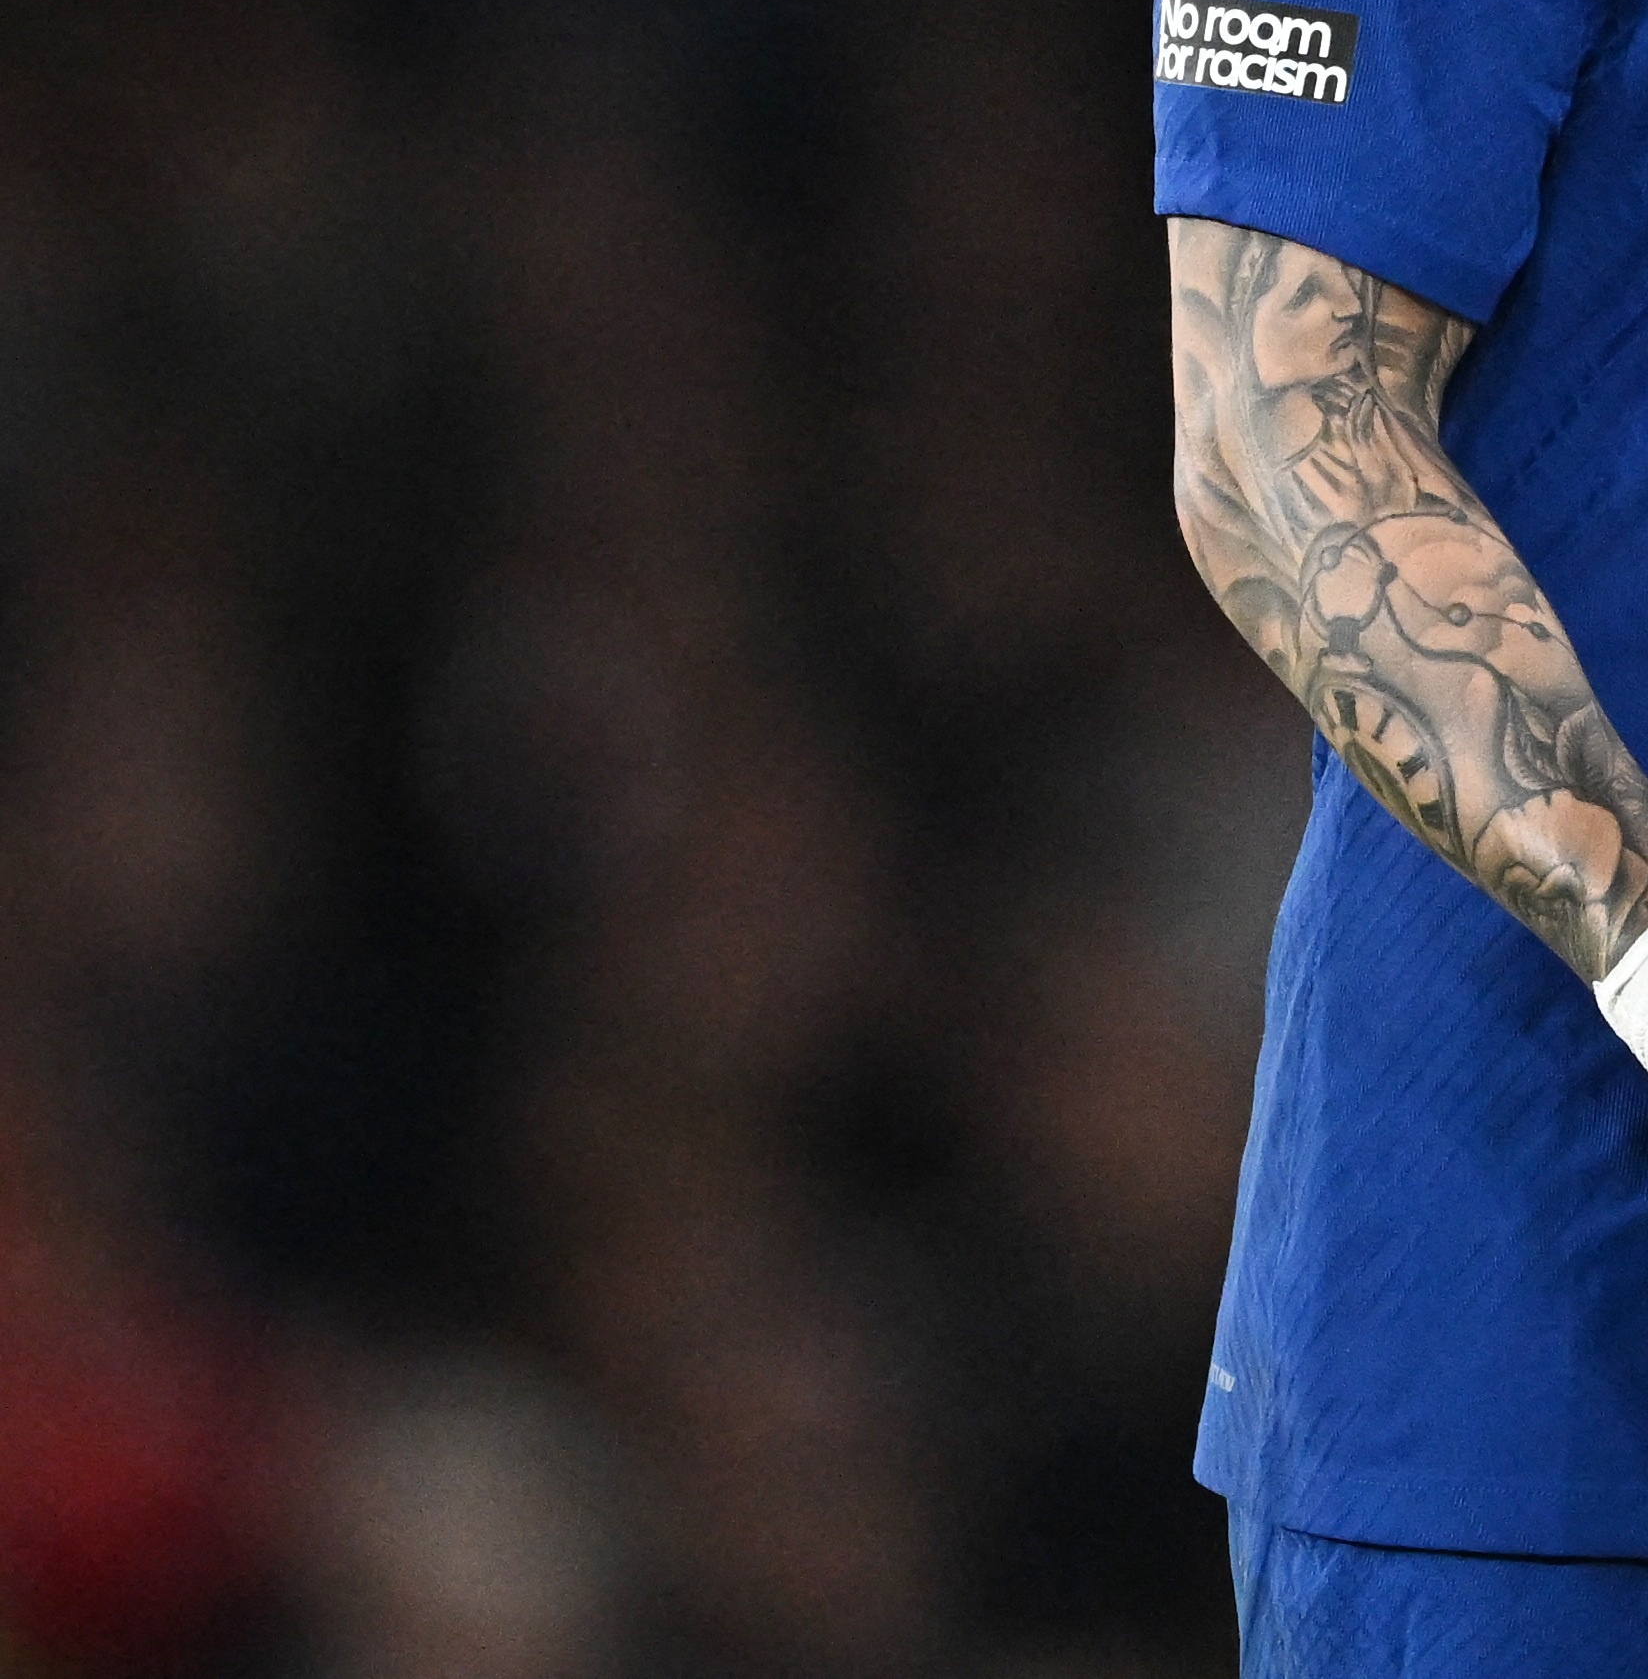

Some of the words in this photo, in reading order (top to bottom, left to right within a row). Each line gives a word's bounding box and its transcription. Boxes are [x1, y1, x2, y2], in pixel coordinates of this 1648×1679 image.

[1203, 6, 1332, 58] room
[1156, 34, 1194, 81] for
[1194, 48, 1348, 103] racism
